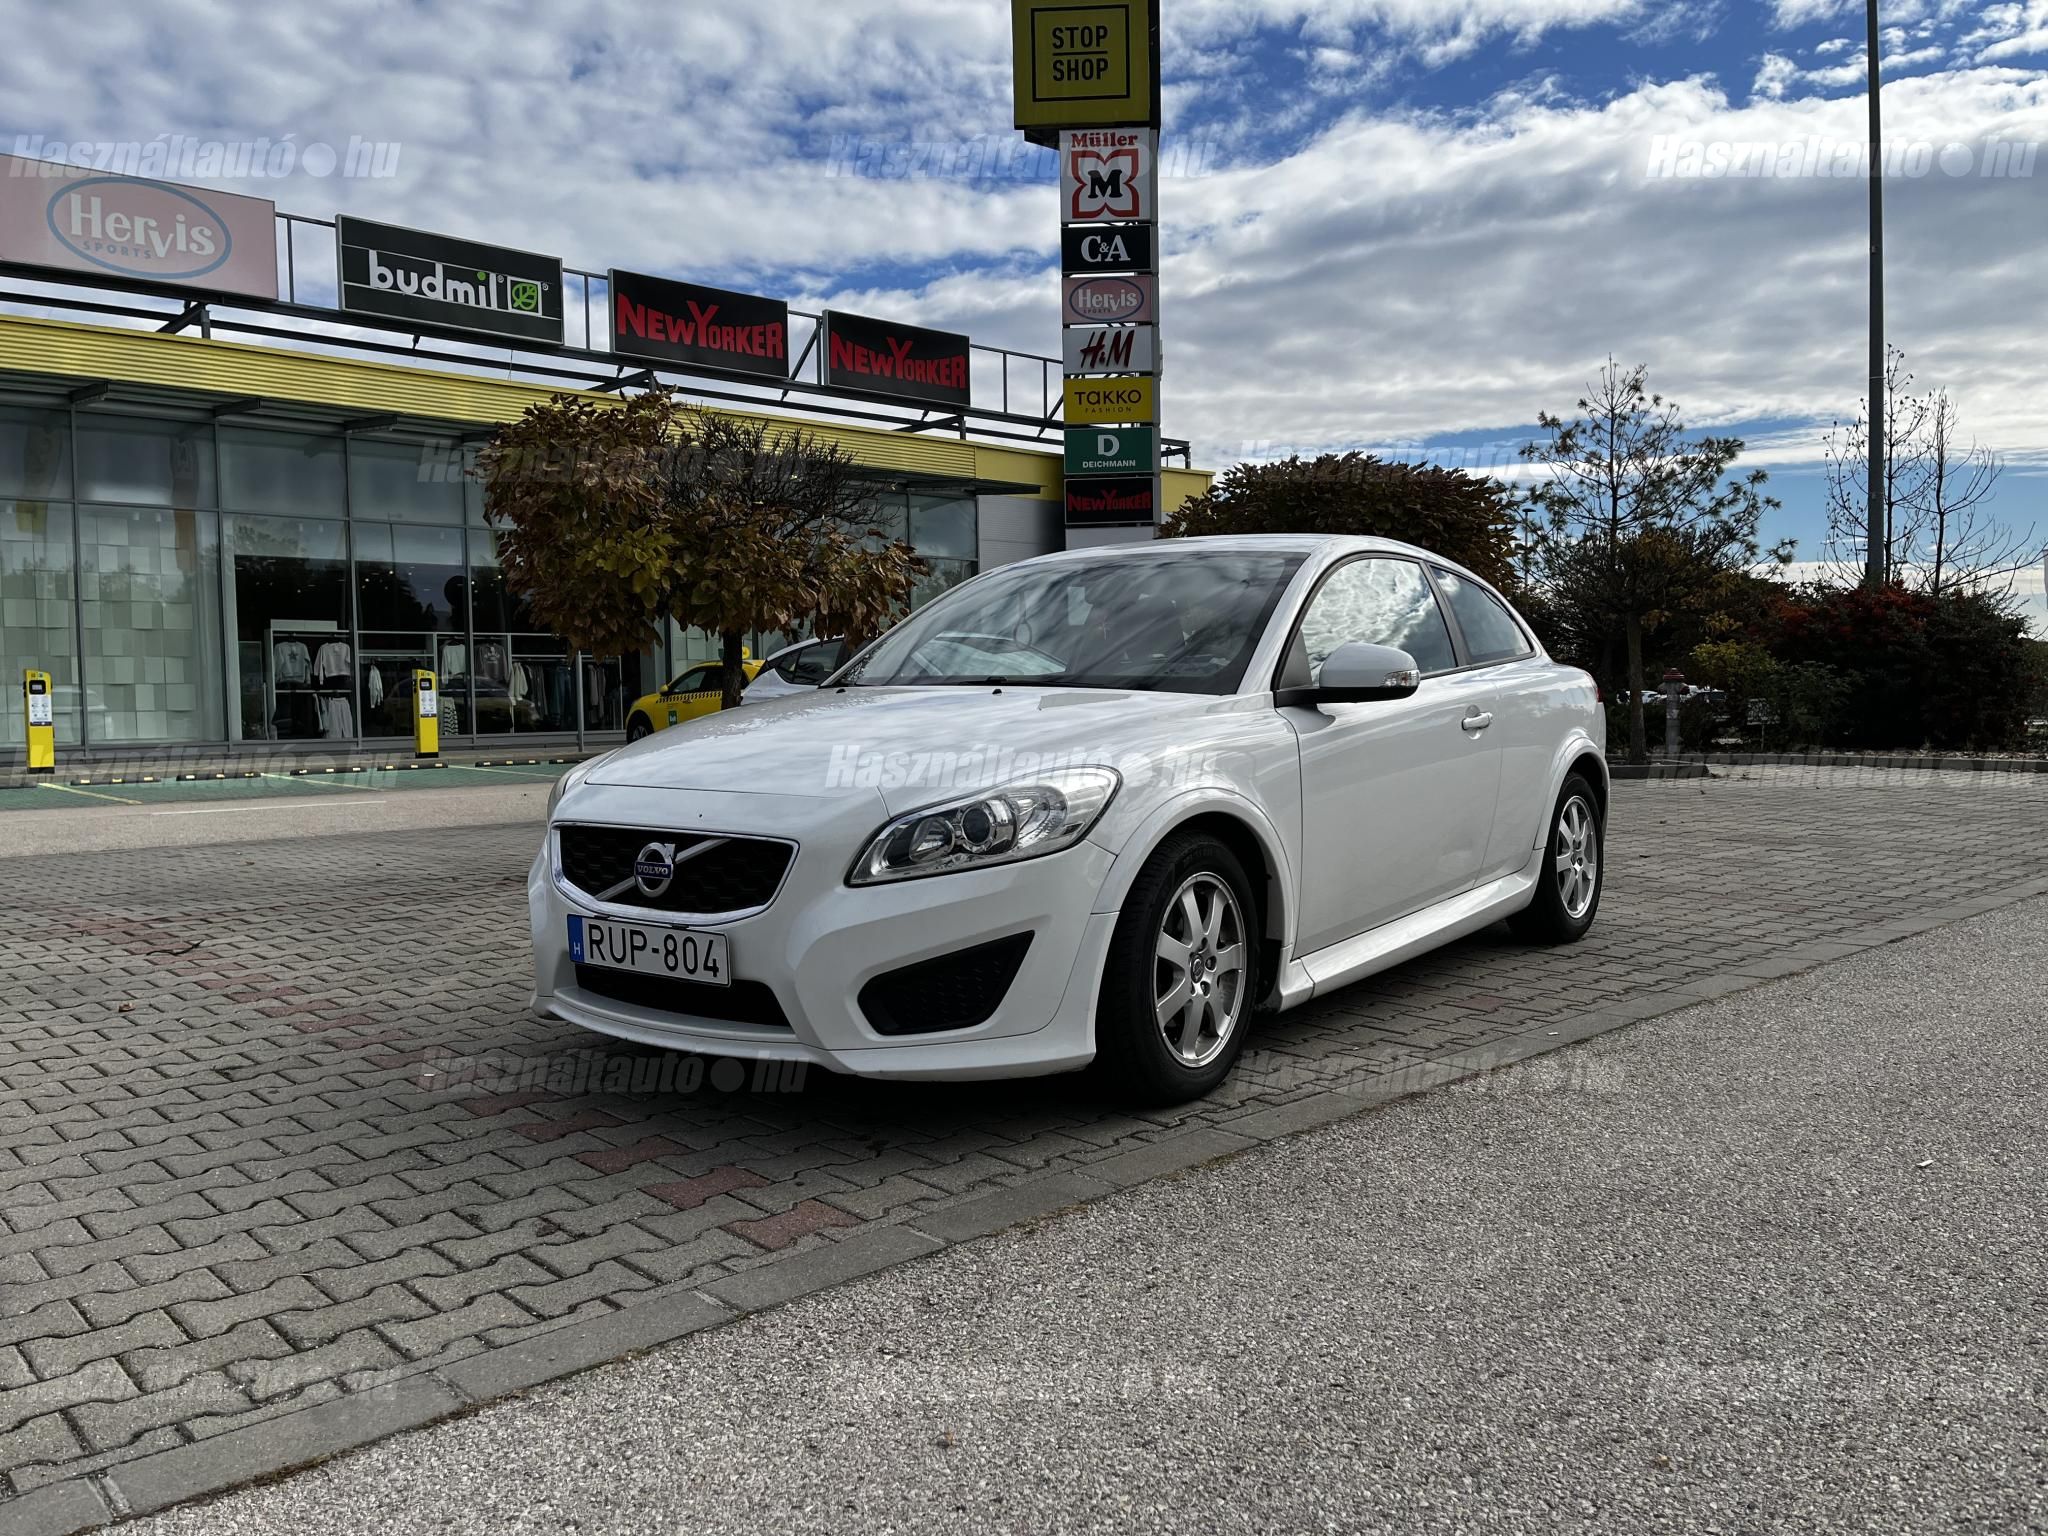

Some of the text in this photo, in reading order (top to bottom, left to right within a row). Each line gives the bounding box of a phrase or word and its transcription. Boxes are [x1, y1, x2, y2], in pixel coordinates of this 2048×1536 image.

[1052, 25, 1108, 49] STOP
[1052, 58, 1109, 81] SHOP
[1071, 132, 1138, 147] Müller
[1088, 169, 1123, 198] M
[70, 192, 215, 258] Hervis
[83, 240, 151, 259] SPORTS
[1081, 235, 1131, 262] C&A
[1078, 288, 1138, 311] Hervis
[1080, 329, 1135, 369] H&M
[1085, 406, 1132, 414] FASHION
[1097, 434, 1120, 457] D
[1082, 459, 1136, 469] DEICHMANN
[637, 864, 669, 876] VOLVO
[574, 924, 720, 978] H RUP-804
